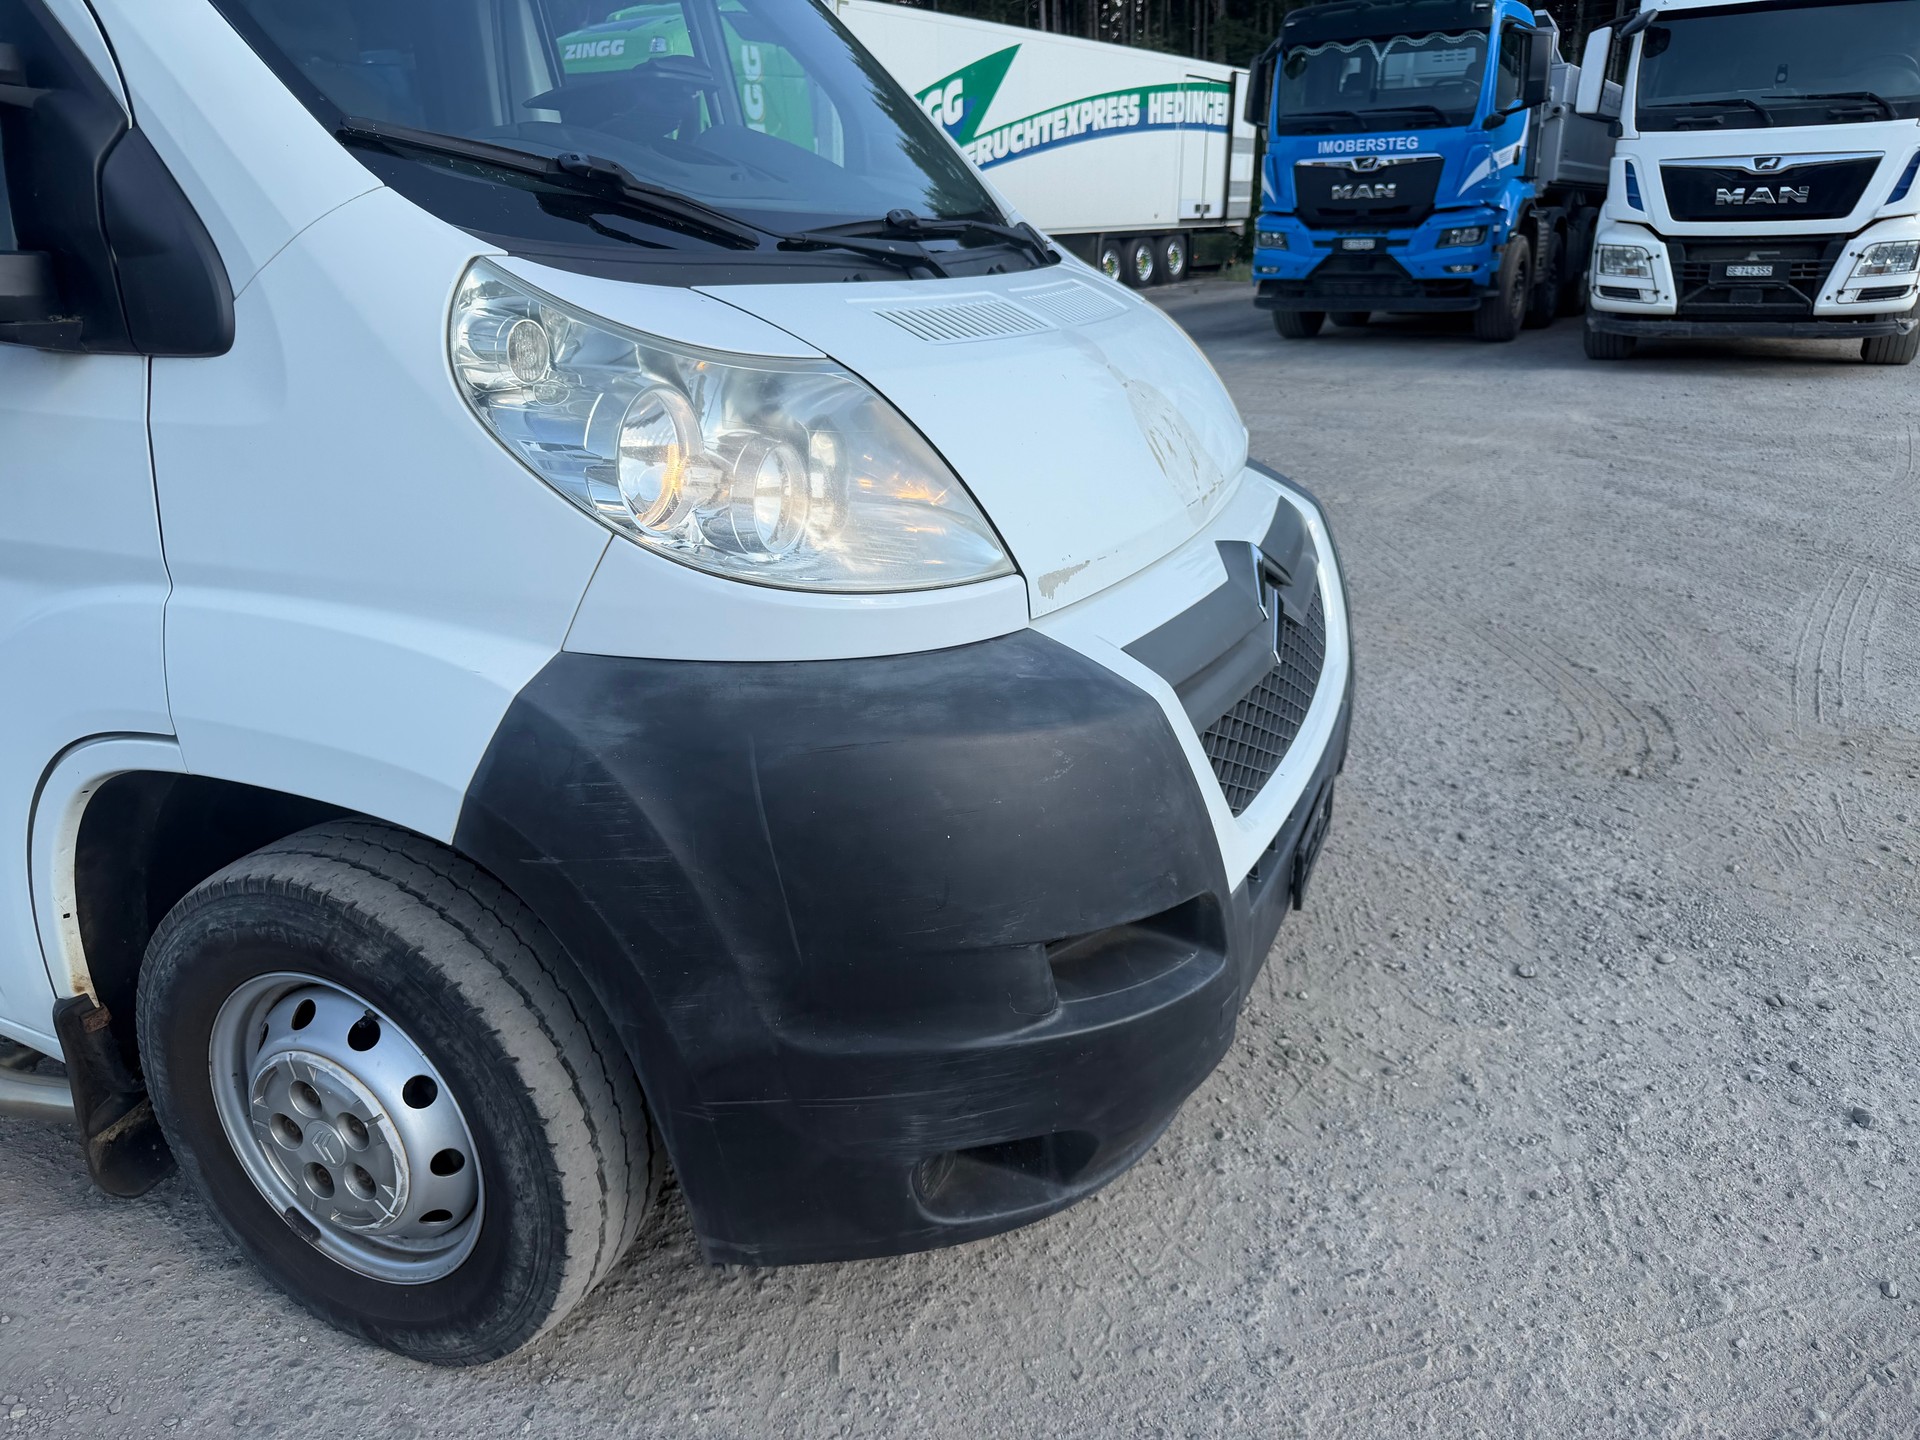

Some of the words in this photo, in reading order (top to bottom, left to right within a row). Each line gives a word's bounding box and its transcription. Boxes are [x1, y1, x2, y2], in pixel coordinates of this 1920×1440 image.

[564, 39, 625, 60] ZINGG
[741, 45, 766, 134] GG
[914, 77, 964, 128] GG
[1317, 136, 1419, 154] IMOBERSTEG
[1331, 183, 1396, 200] MAN
[1715, 185, 1810, 206] MAN
